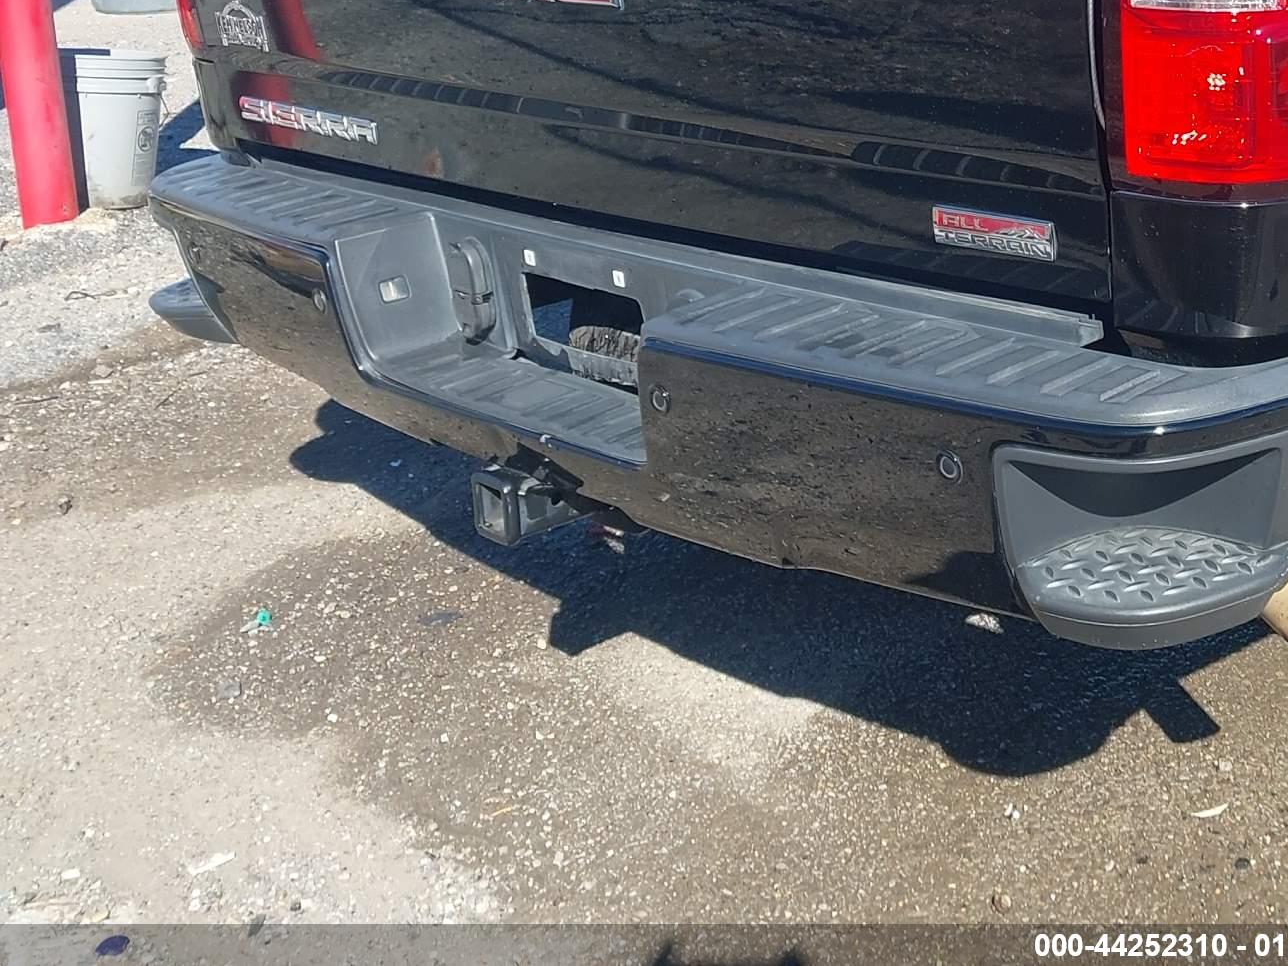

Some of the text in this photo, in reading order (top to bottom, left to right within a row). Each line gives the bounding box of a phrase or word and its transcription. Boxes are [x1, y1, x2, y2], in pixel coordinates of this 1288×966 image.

[239, 96, 377, 145] SIERRA
[942, 214, 989, 231] ALL
[938, 229, 1050, 257] TERRAIN
